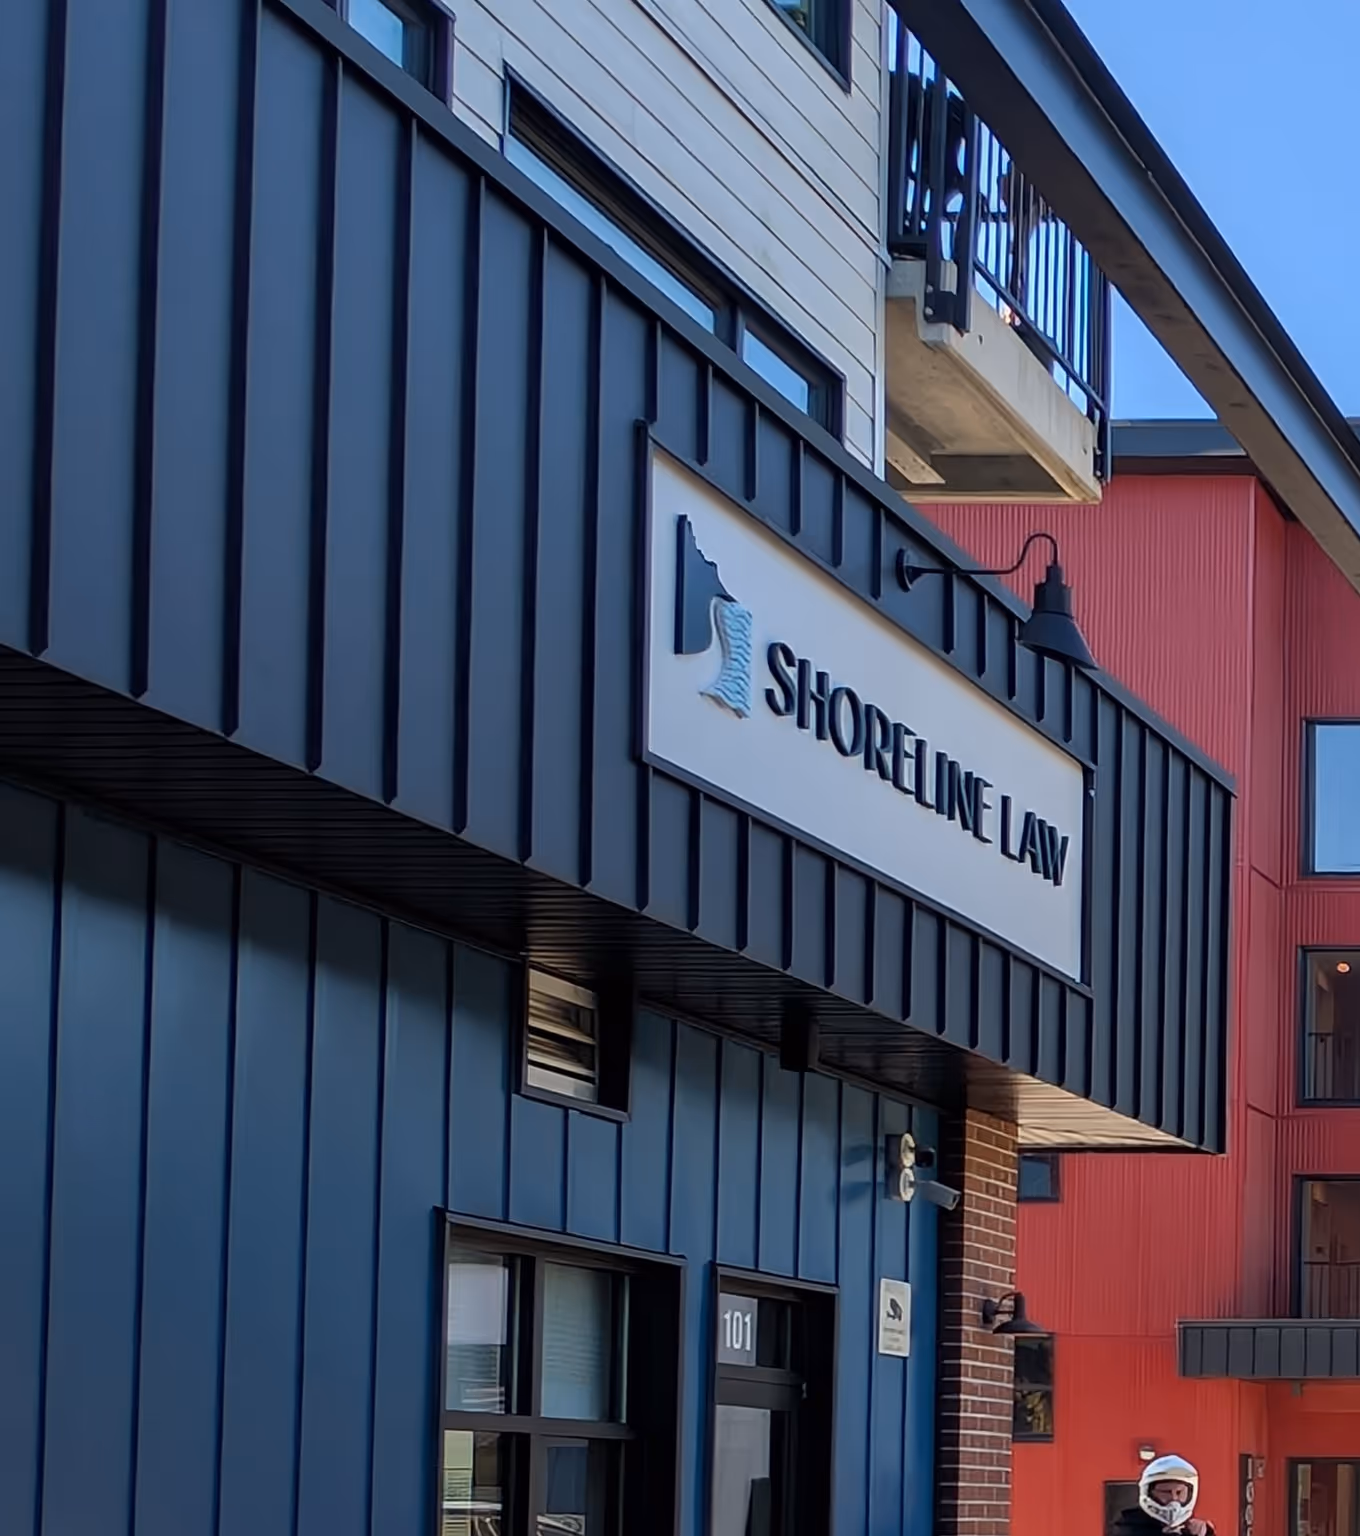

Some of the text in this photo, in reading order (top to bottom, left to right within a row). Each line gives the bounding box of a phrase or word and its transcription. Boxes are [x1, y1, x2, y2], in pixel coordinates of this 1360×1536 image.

[765, 641, 1069, 886] SHORELINE LAW
[724, 1310, 752, 1351] 101
